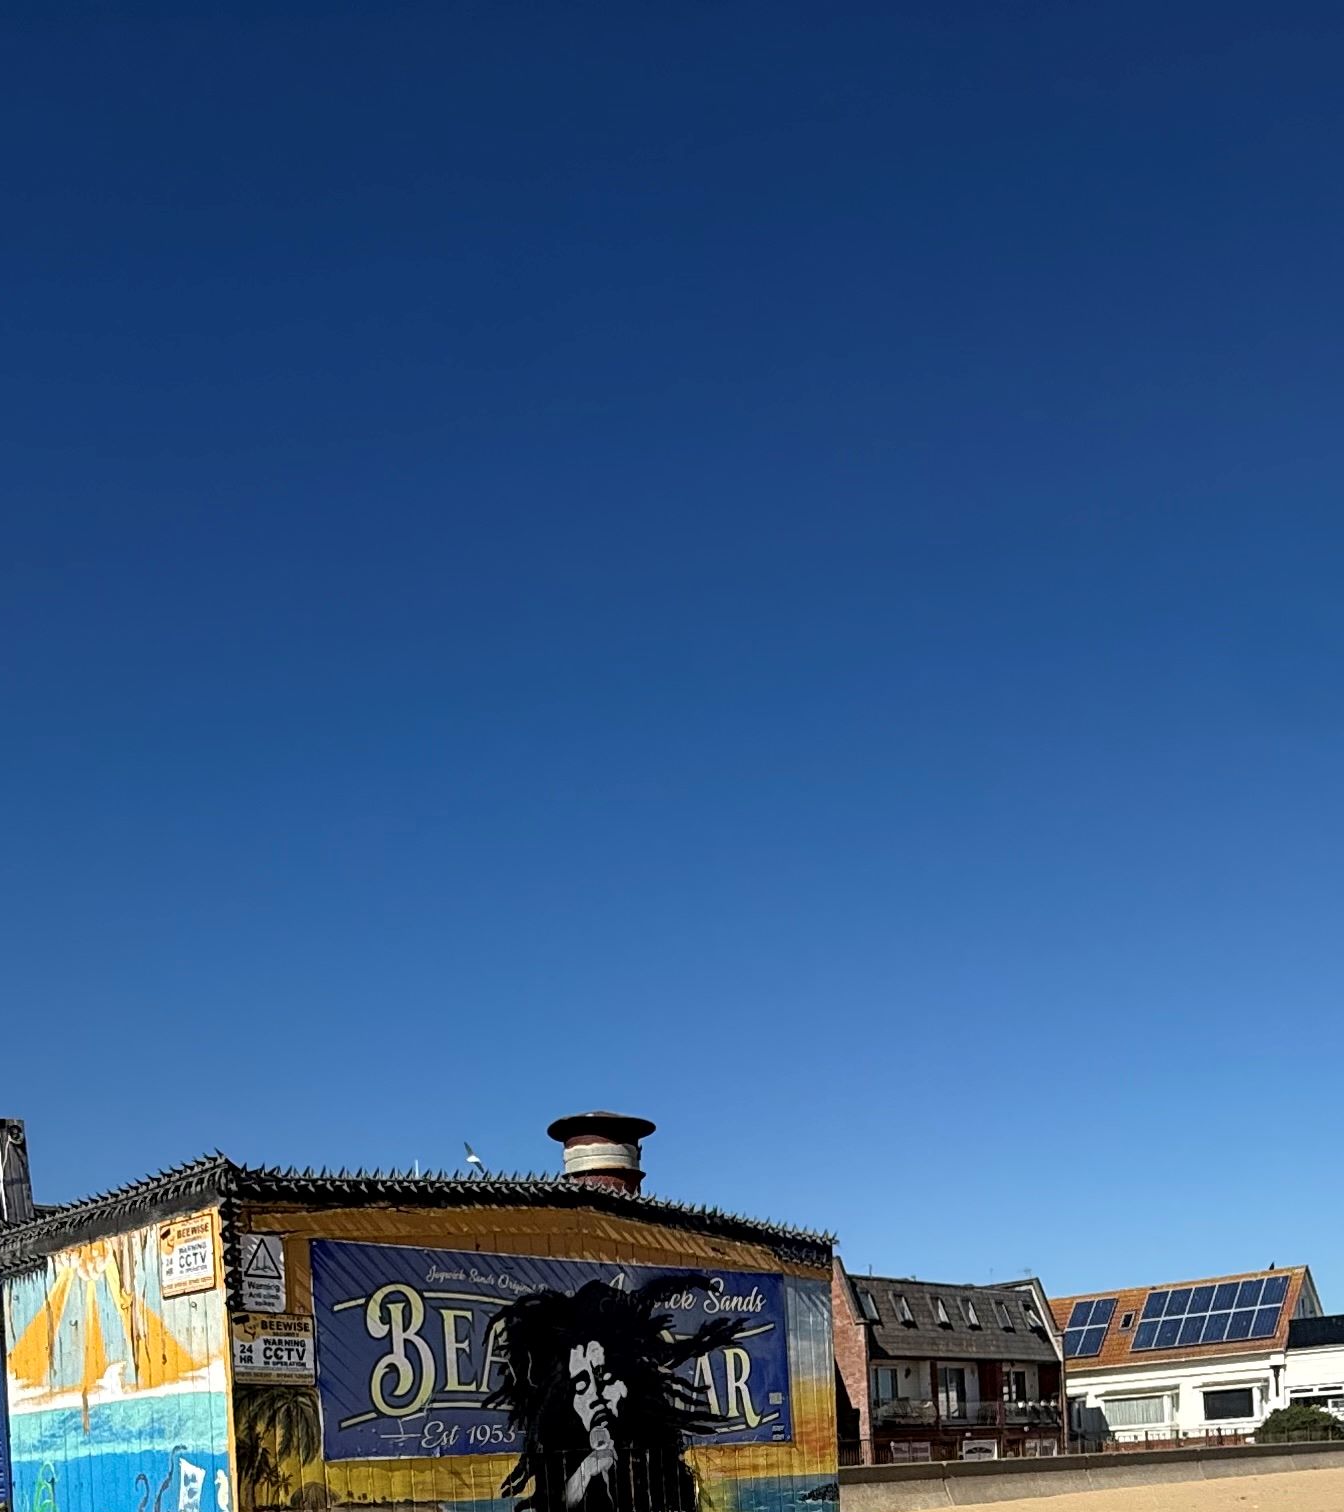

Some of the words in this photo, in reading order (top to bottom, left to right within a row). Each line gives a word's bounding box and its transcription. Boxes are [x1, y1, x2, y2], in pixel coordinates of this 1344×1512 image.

[179, 1250, 207, 1269] CCTV
[468, 1268, 495, 1286] Sands
[703, 1277, 766, 1314] Sands
[261, 1320, 310, 1332] BEEWISE
[239, 1344, 253, 1354] 24
[263, 1338, 306, 1347] WARNING
[239, 1355, 253, 1364] HR
[263, 1347, 306, 1361] CCTV
[421, 1421, 459, 1448] Est
